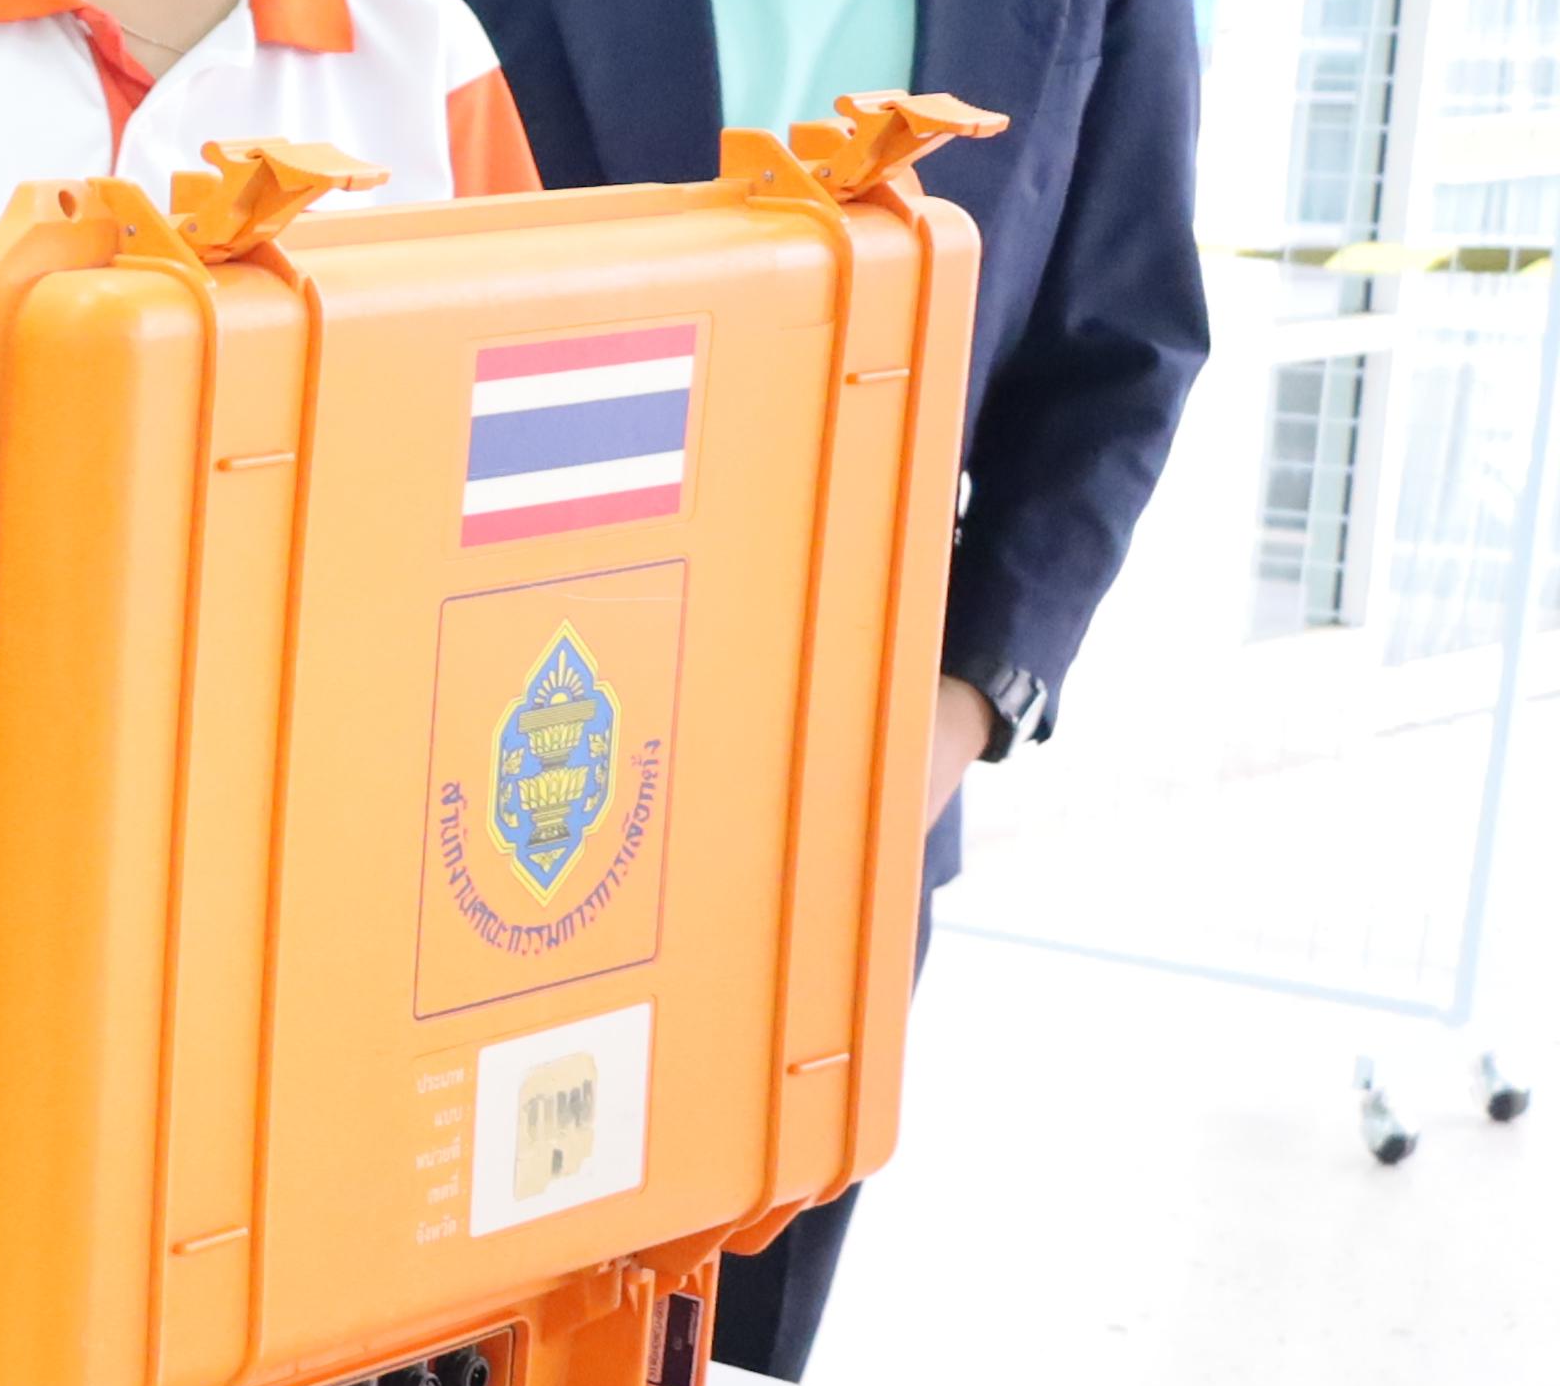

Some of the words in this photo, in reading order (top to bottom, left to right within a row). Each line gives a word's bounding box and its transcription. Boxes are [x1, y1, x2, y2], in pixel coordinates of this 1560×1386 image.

[439, 737, 662, 955] สำนักงานคณะกรรมการการเลือกตั้ง
